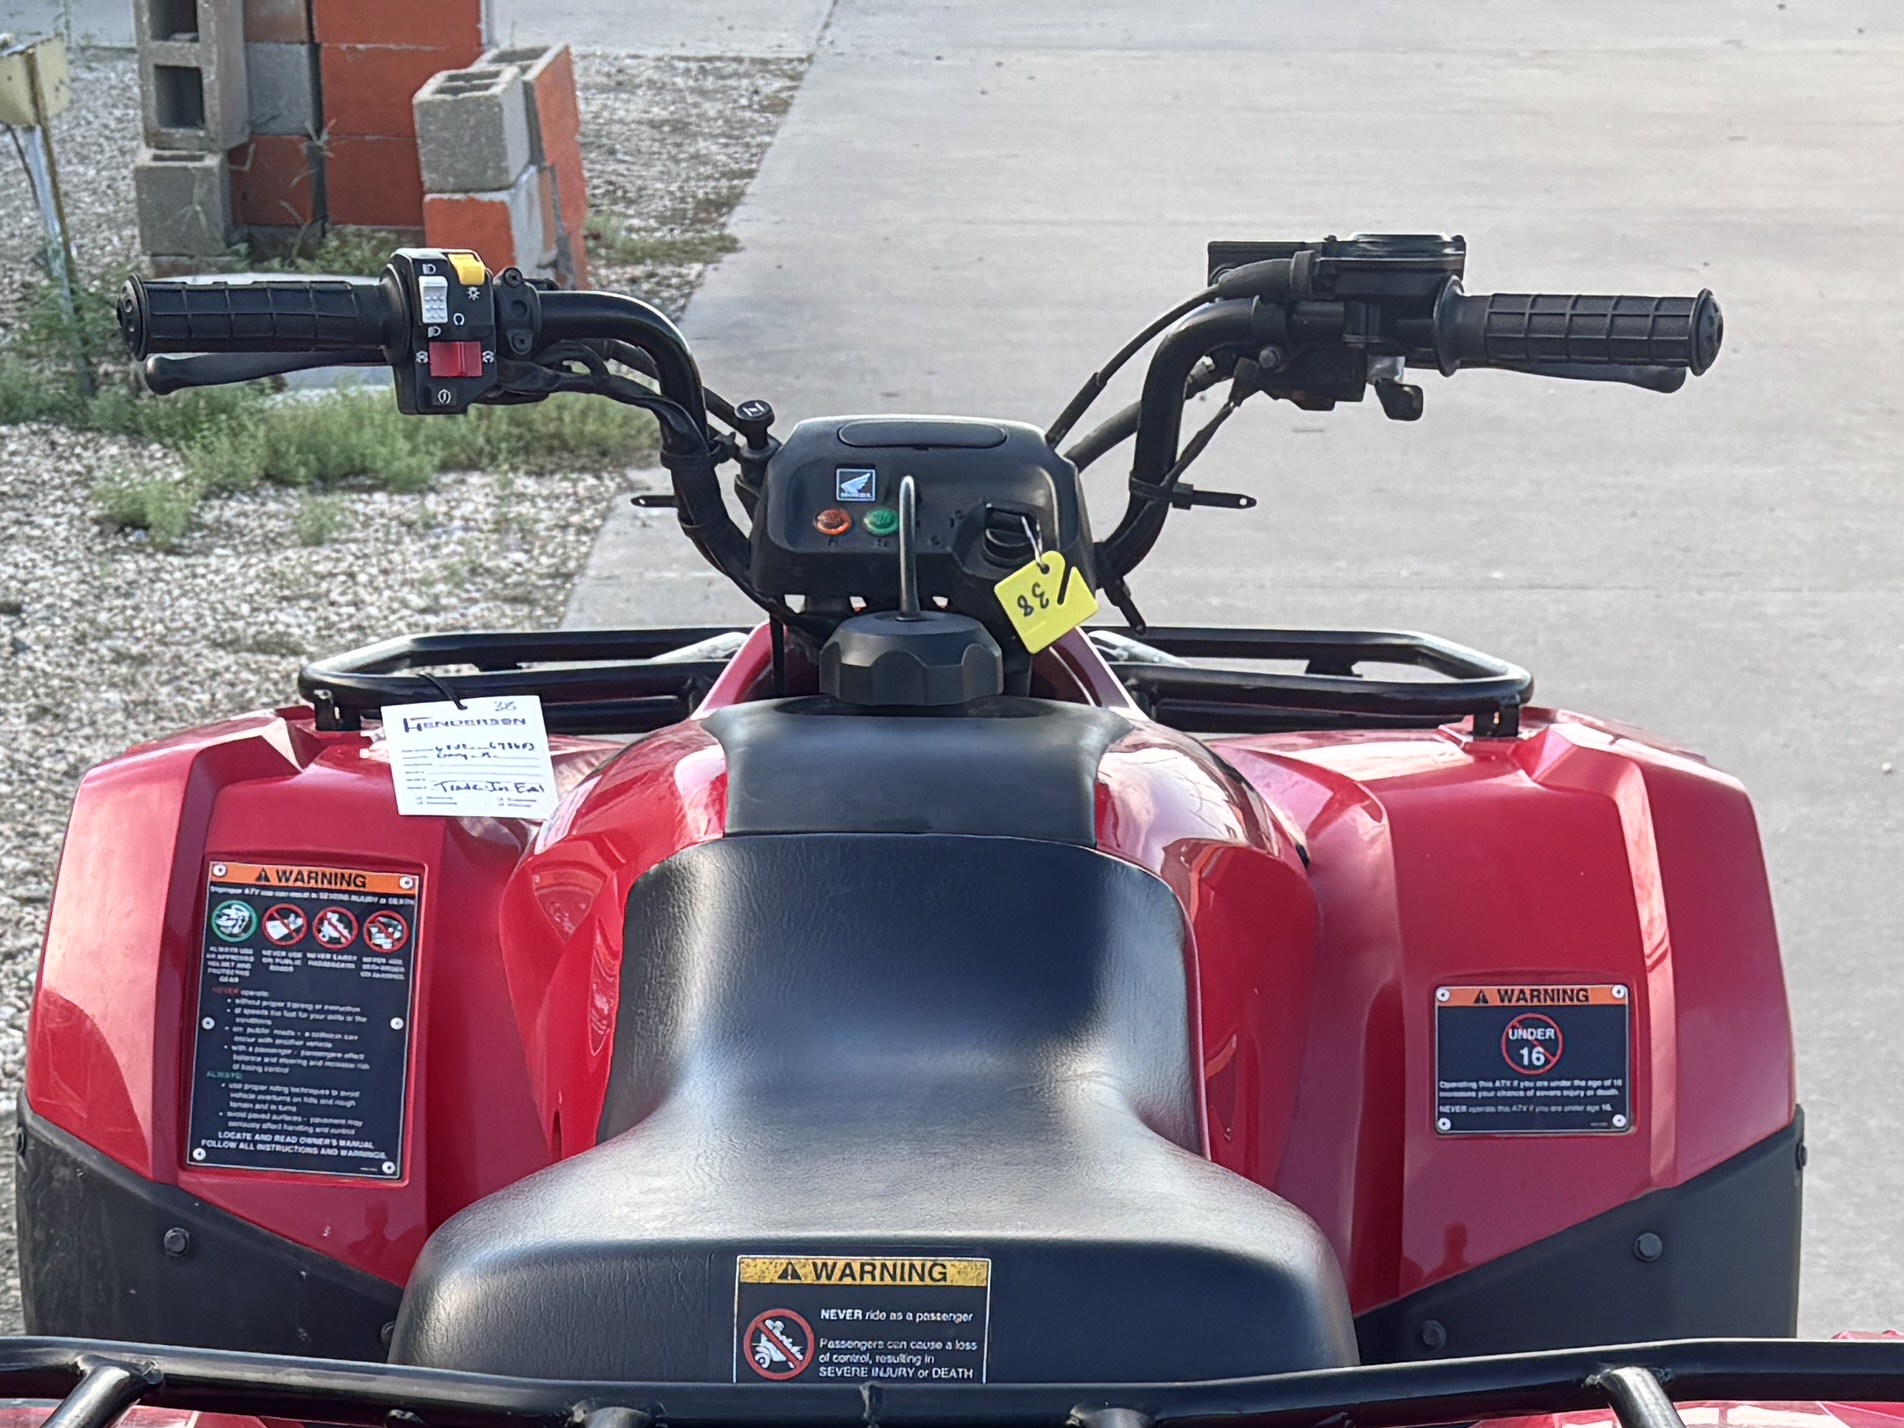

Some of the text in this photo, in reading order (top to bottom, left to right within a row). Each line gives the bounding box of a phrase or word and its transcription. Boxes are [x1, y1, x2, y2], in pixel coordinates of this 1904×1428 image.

[276, 869, 367, 889] WARNING
[1497, 988, 1589, 1003] WARNING
[1508, 1028, 1556, 1040] UNDER
[1519, 1046, 1546, 1066] 16
[238, 1141, 254, 1150] ALL
[812, 1262, 948, 1282] WARNING
[821, 1309, 973, 1324] NEVER ride as a passenger
[819, 1338, 884, 1351] Passengers
[887, 1341, 907, 1349] can
[909, 1341, 943, 1350] cause
[955, 1339, 977, 1350] loss
[832, 1353, 872, 1364] control,
[875, 1353, 922, 1366] resulting
[819, 1366, 973, 1378] SEVERE INJURY or DEATH
